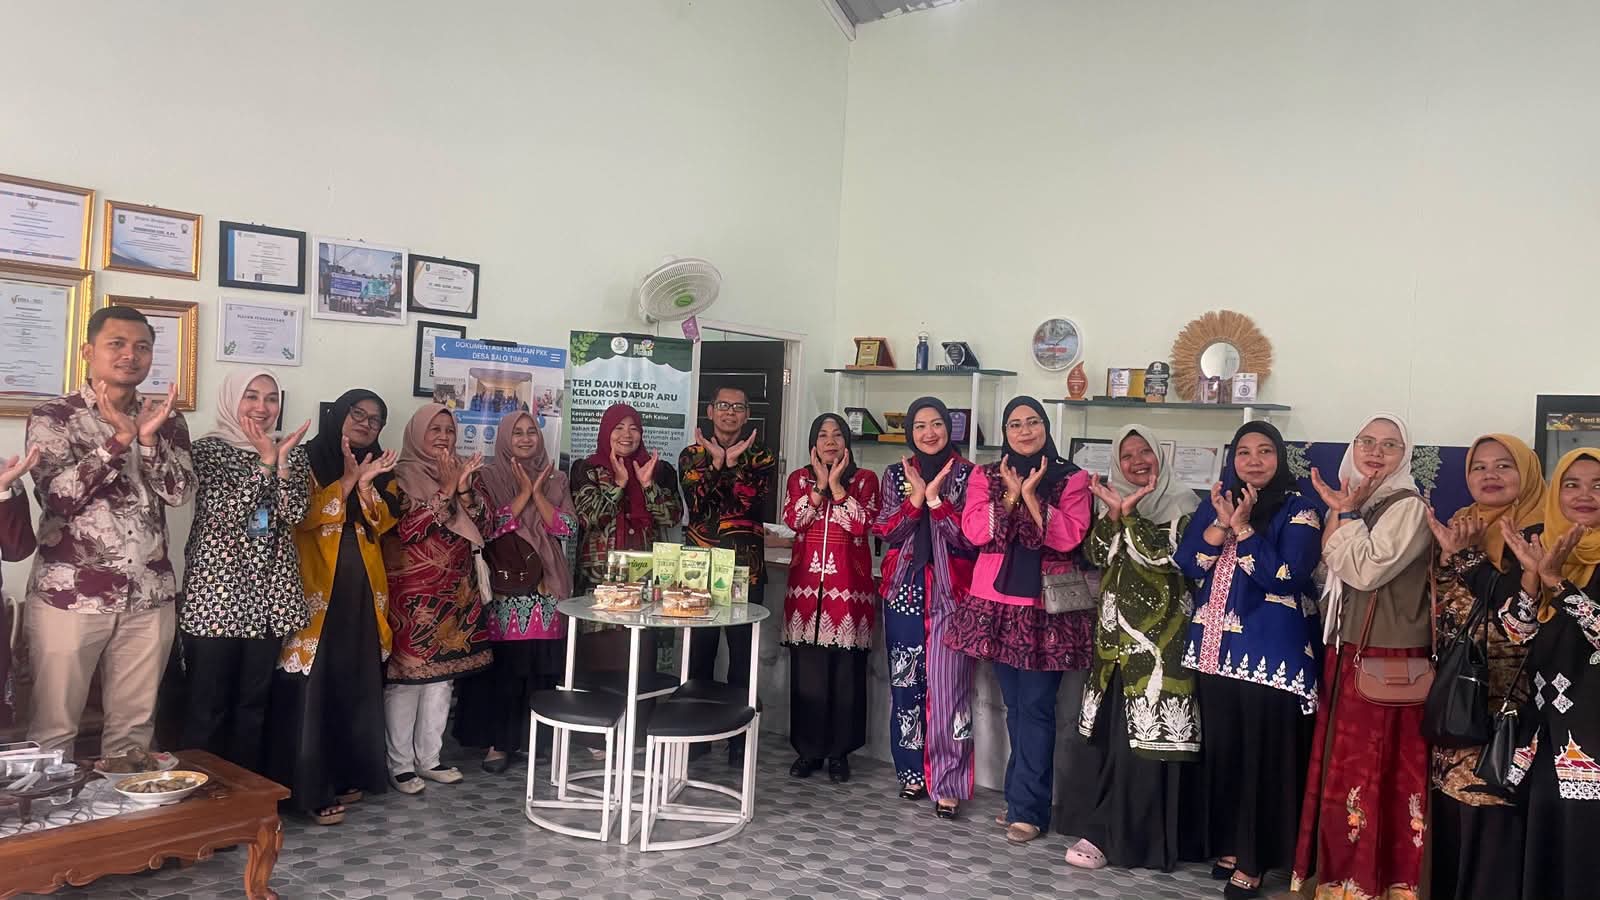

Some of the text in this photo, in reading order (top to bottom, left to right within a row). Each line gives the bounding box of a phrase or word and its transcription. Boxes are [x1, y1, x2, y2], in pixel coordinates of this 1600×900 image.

[472, 352, 529, 363] DESA SALO TIMUR
[572, 379, 657, 391] TEH DAUN KELOR
[572, 388, 678, 402] KELOROS DAPUR ARU
[572, 398, 606, 406] MEMIKAT
[632, 401, 660, 409] GLOBAL
